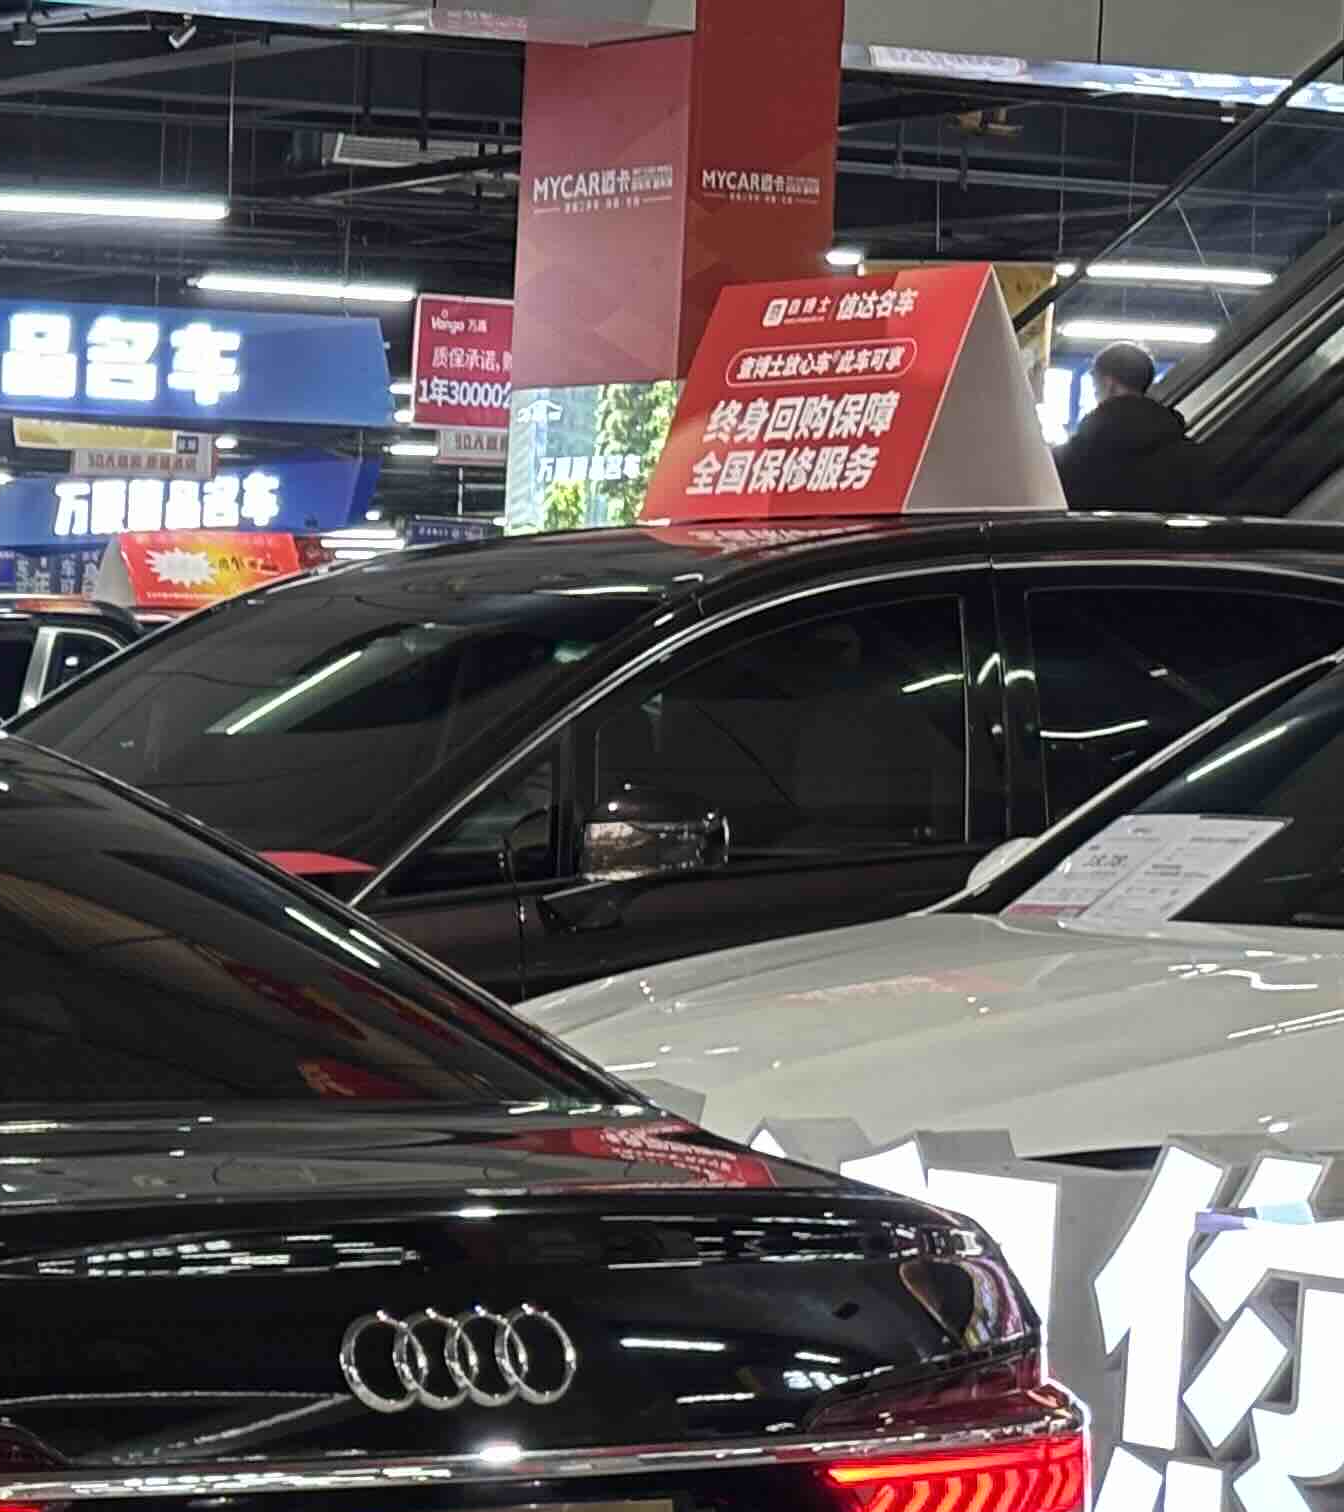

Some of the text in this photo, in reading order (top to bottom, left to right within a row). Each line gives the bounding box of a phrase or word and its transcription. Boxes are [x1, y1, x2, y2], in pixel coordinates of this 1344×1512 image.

[431, 315, 465, 335] Vango
[702, 389, 901, 443] 终身回购保障
[686, 444, 881, 495] 全国保修服务
